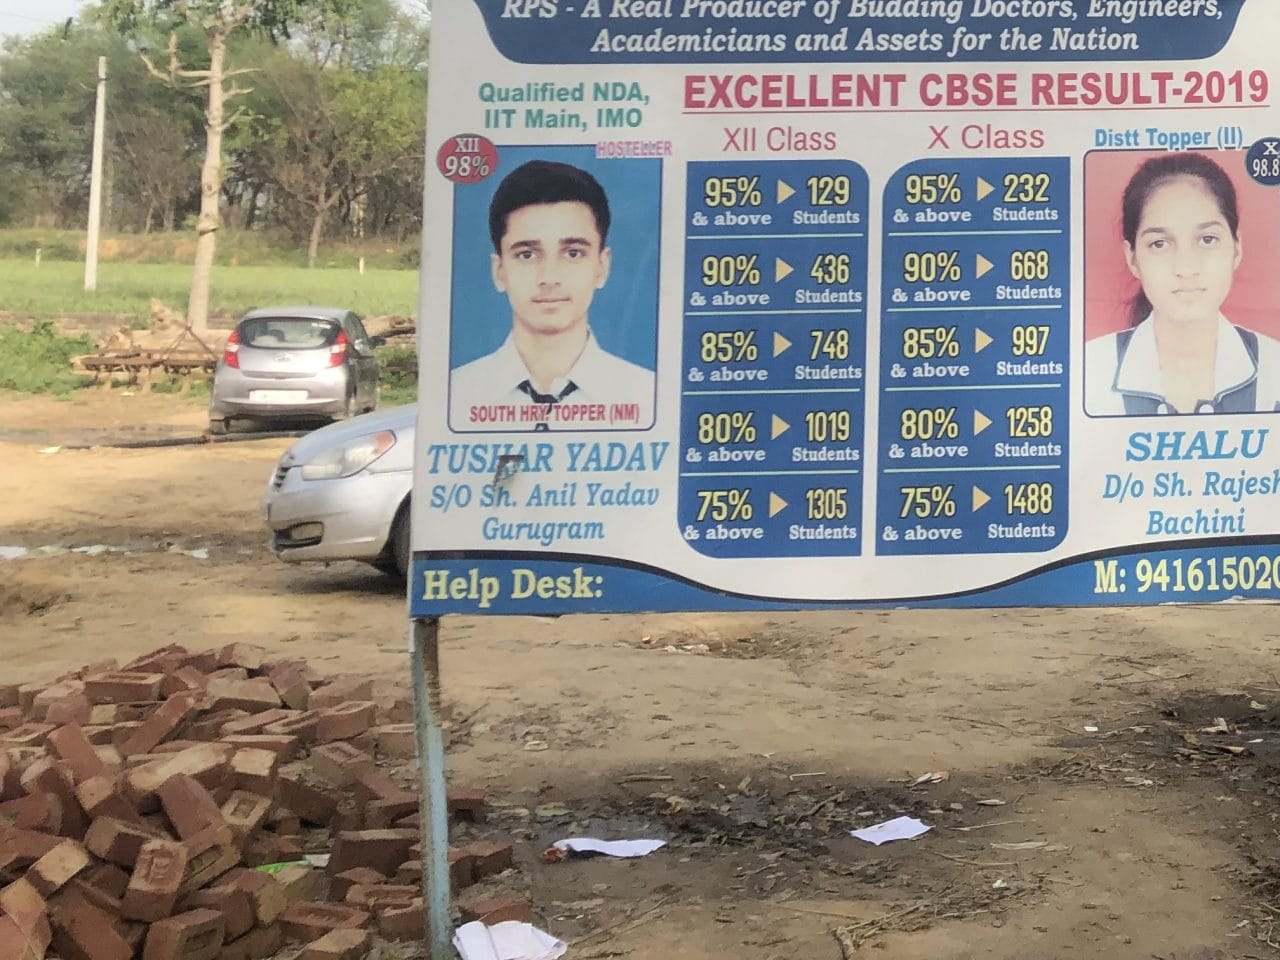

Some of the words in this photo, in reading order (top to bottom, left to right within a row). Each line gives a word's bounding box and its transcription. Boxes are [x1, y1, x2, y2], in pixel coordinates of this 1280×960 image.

[590, 28, 787, 53] Academicians
[794, 27, 848, 52] and
[854, 28, 943, 52] Assets
[947, 26, 992, 57] for
[1000, 27, 1046, 52] the
[1049, 28, 1140, 51] Nation
[478, 81, 585, 104] Qualified
[592, 82, 650, 106] NDA,
[684, 73, 906, 108] EXCELLENT
[919, 73, 1018, 107] CBSE
[1031, 69, 1270, 106] RESULT-2019
[484, 109, 516, 129] IIT
[524, 109, 588, 132] Main,
[597, 108, 643, 128] IMO
[454, 137, 480, 153] XII
[598, 141, 672, 157] HOSTELLER
[722, 129, 757, 152] XII
[766, 127, 837, 152] Class
[928, 126, 950, 149] X
[961, 124, 1045, 149] Class
[1094, 127, 1140, 148] Distt
[1145, 128, 1213, 150] Topper
[1217, 126, 1244, 150] (II)
[444, 155, 490, 177] 98%
[704, 176, 761, 207] 95%
[806, 174, 850, 206] 129
[904, 173, 961, 205] 95%
[1002, 172, 1050, 204] 232
[691, 212, 709, 226] &
[713, 212, 772, 226] above
[793, 209, 860, 225] Students
[893, 209, 909, 223] &
[915, 208, 972, 223] above
[992, 206, 1059, 222] Students
[702, 254, 760, 287] 90%
[809, 253, 850, 285] 436
[903, 251, 962, 283] 90%
[1009, 250, 1050, 281] 668
[690, 292, 706, 306] &
[712, 291, 770, 306] above
[795, 288, 862, 304] Students
[892, 288, 908, 303] &
[914, 287, 971, 302] above
[996, 284, 1062, 300] Students
[700, 331, 758, 363] 85%
[809, 329, 850, 361] 748
[902, 326, 960, 359] 85%
[1011, 324, 1050, 357] 997
[688, 368, 705, 382] &
[710, 367, 769, 382] above
[794, 364, 861, 380] Students
[890, 364, 907, 378] &
[912, 363, 970, 377] above
[996, 360, 1063, 376] Students
[469, 405, 515, 422] SOUTH
[554, 404, 606, 421] TOPPER
[609, 403, 640, 424] (NM)
[698, 411, 757, 444] 80%
[804, 410, 850, 442] 1019
[900, 407, 960, 441] 80%
[1005, 405, 1053, 438] 1258
[428, 442, 554, 474] TUSHAR
[566, 441, 670, 473] YADAV
[686, 448, 702, 463] &
[708, 447, 766, 462] above
[791, 446, 860, 462] Students
[888, 444, 906, 458] &
[911, 442, 968, 458] above
[994, 441, 1062, 457] Students
[1125, 429, 1269, 462] SHALU
[430, 483, 472, 513] S/O
[479, 483, 517, 508] Sh.
[528, 483, 577, 507] Anil
[585, 482, 660, 507] Yadav
[899, 485, 957, 519] 75%
[1004, 482, 1053, 516] 1488
[1102, 473, 1145, 504] D/o
[1152, 472, 1193, 497] Sh.
[696, 489, 753, 522] 75%
[805, 487, 848, 520] 1305
[482, 516, 605, 547] Gurugram
[684, 526, 700, 541] &
[705, 524, 764, 540] above
[789, 524, 857, 540] Students
[882, 526, 899, 541] &
[904, 525, 963, 540] above
[988, 522, 1056, 539] Students
[1146, 509, 1246, 536] Bachini
[422, 569, 499, 608] Help
[511, 568, 603, 599] Desk:
[1094, 559, 1126, 594] M:
